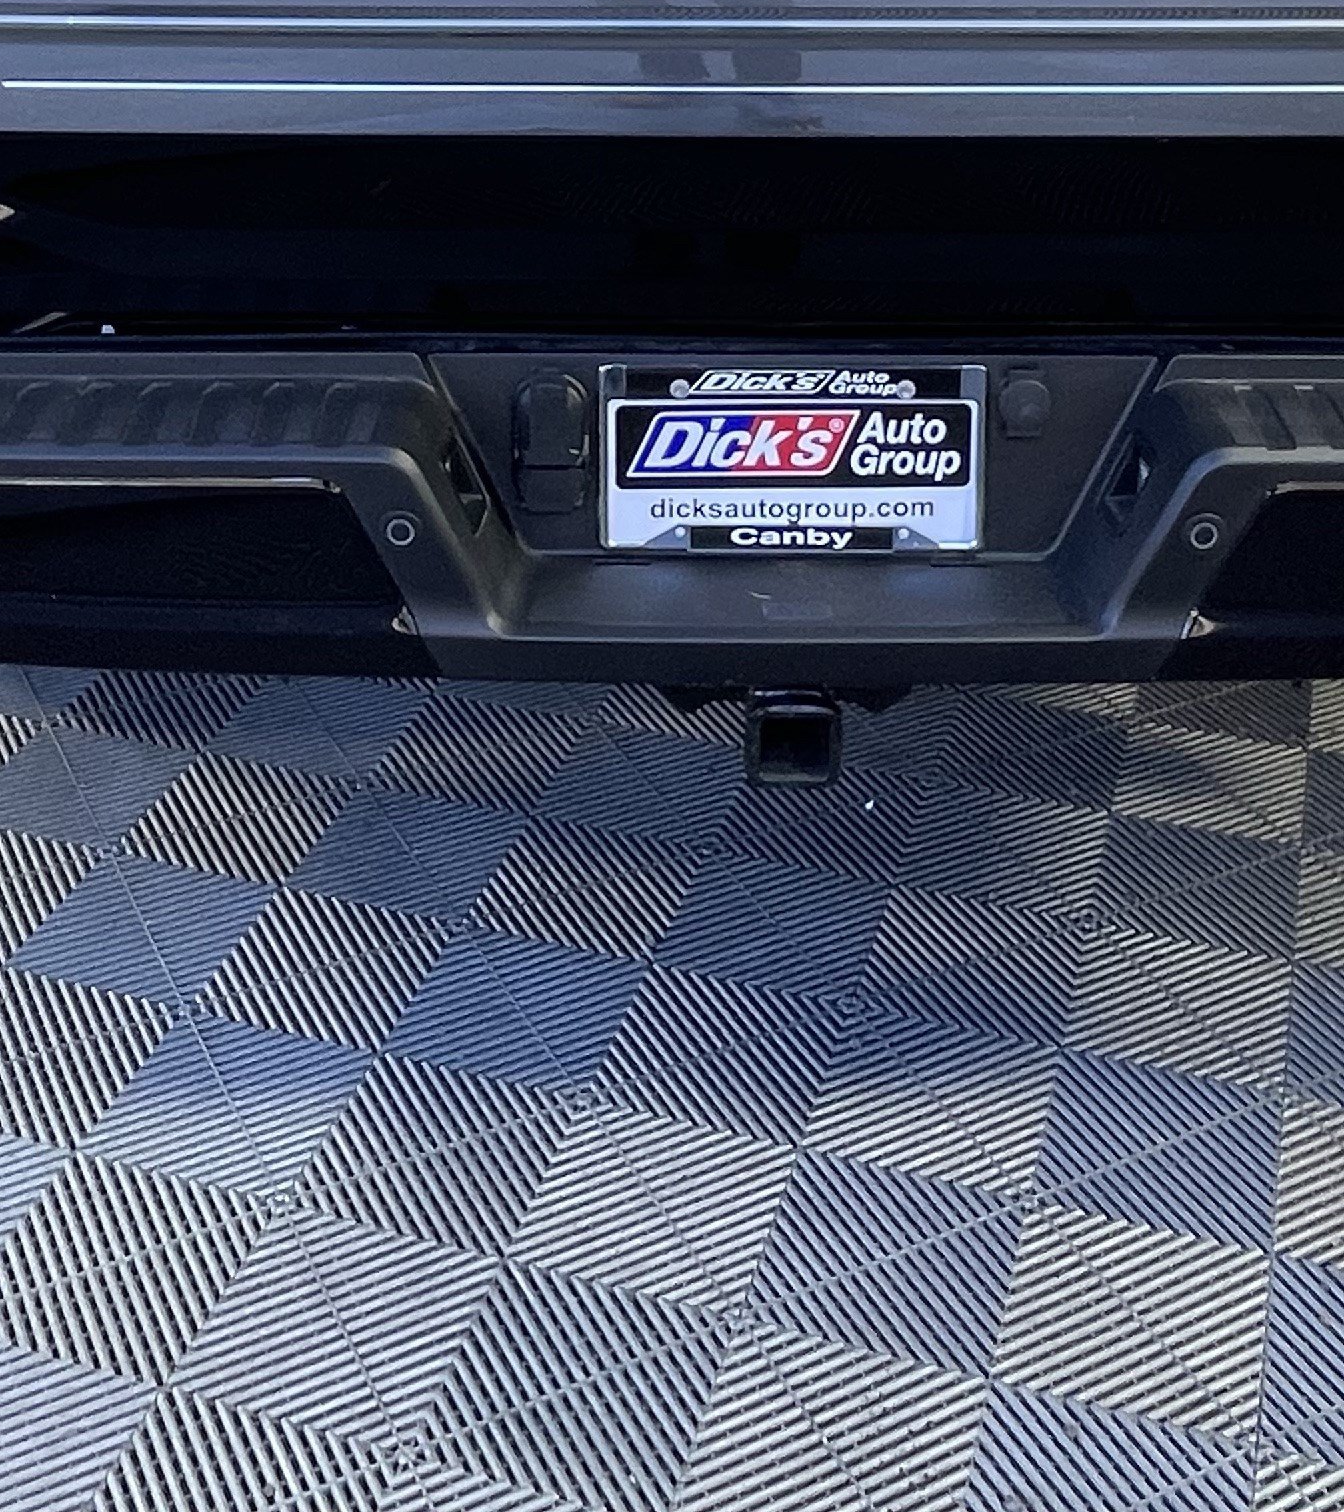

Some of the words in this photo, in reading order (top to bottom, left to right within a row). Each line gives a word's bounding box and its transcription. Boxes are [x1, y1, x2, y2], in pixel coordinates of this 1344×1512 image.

[828, 382, 897, 396] Group
[834, 370, 890, 383] Auto
[856, 411, 946, 444] Auto
[850, 444, 962, 482] Group
[650, 497, 934, 525] dicksautogroup.com
[730, 527, 853, 550] Canby
